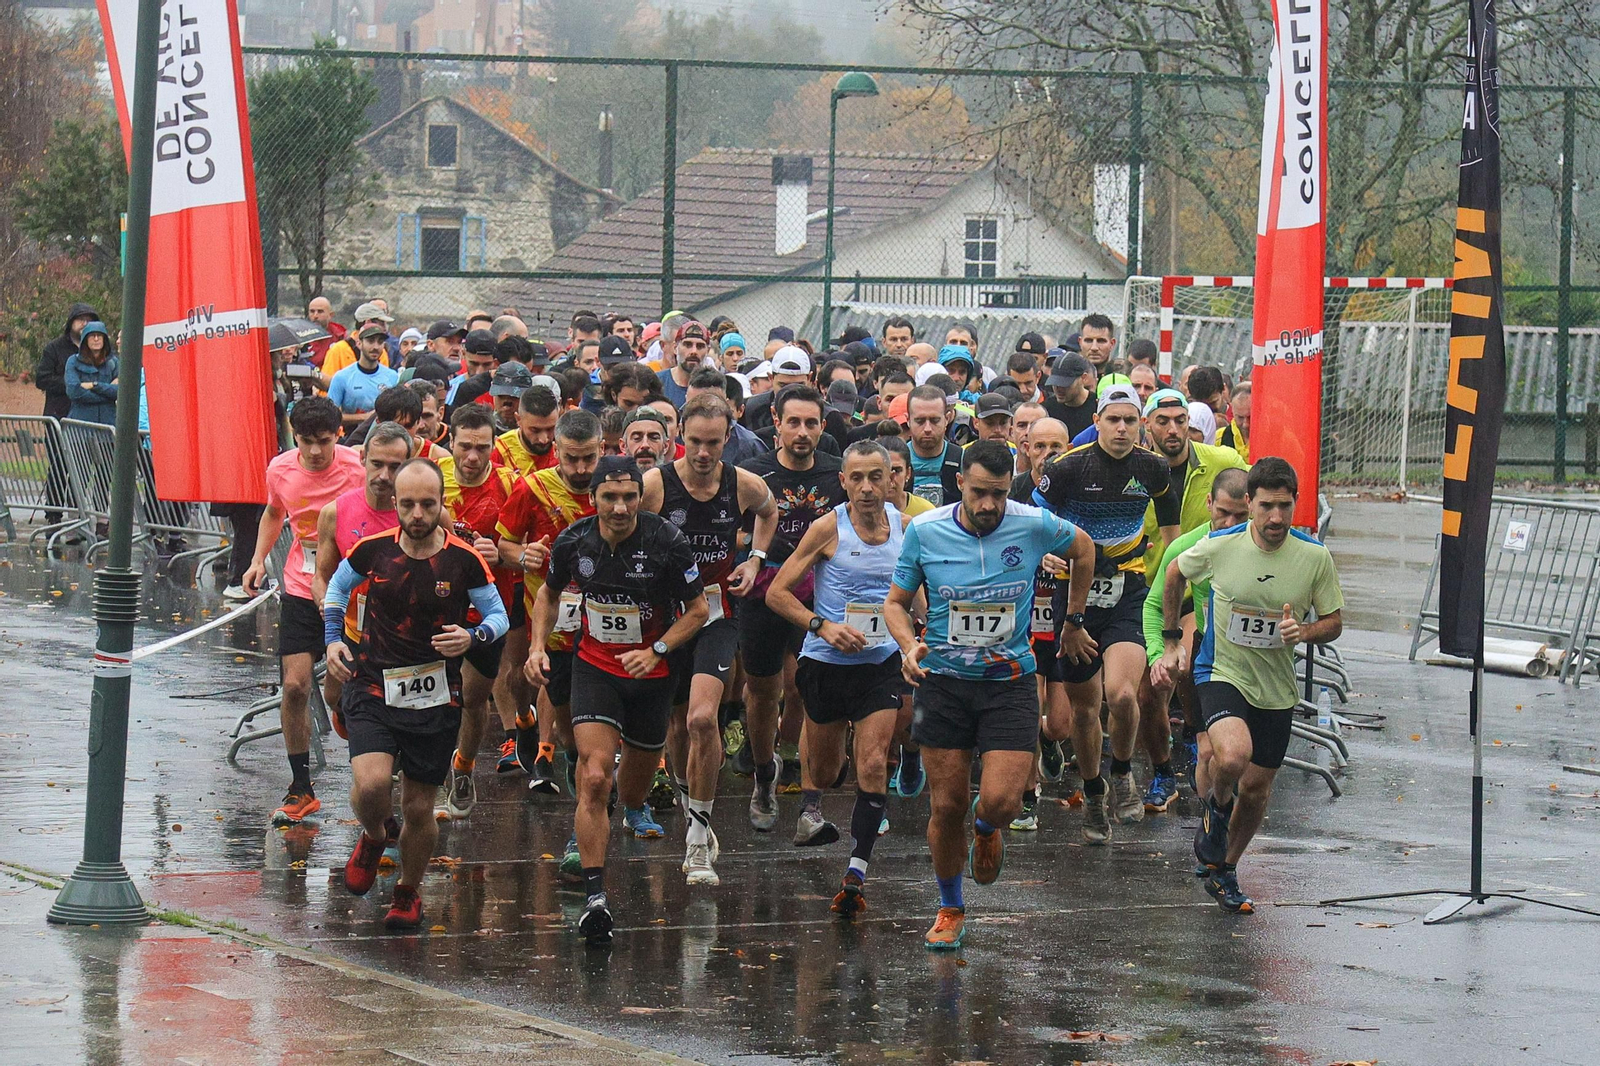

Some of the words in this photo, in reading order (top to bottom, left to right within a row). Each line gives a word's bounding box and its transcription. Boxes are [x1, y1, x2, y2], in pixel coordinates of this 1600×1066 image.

[692, 549, 729, 563] ONERS
[602, 615, 628, 631] 58
[870, 616, 879, 633] 1
[961, 615, 1002, 633] 117
[1241, 617, 1277, 636] 131
[397, 675, 436, 697] 140
